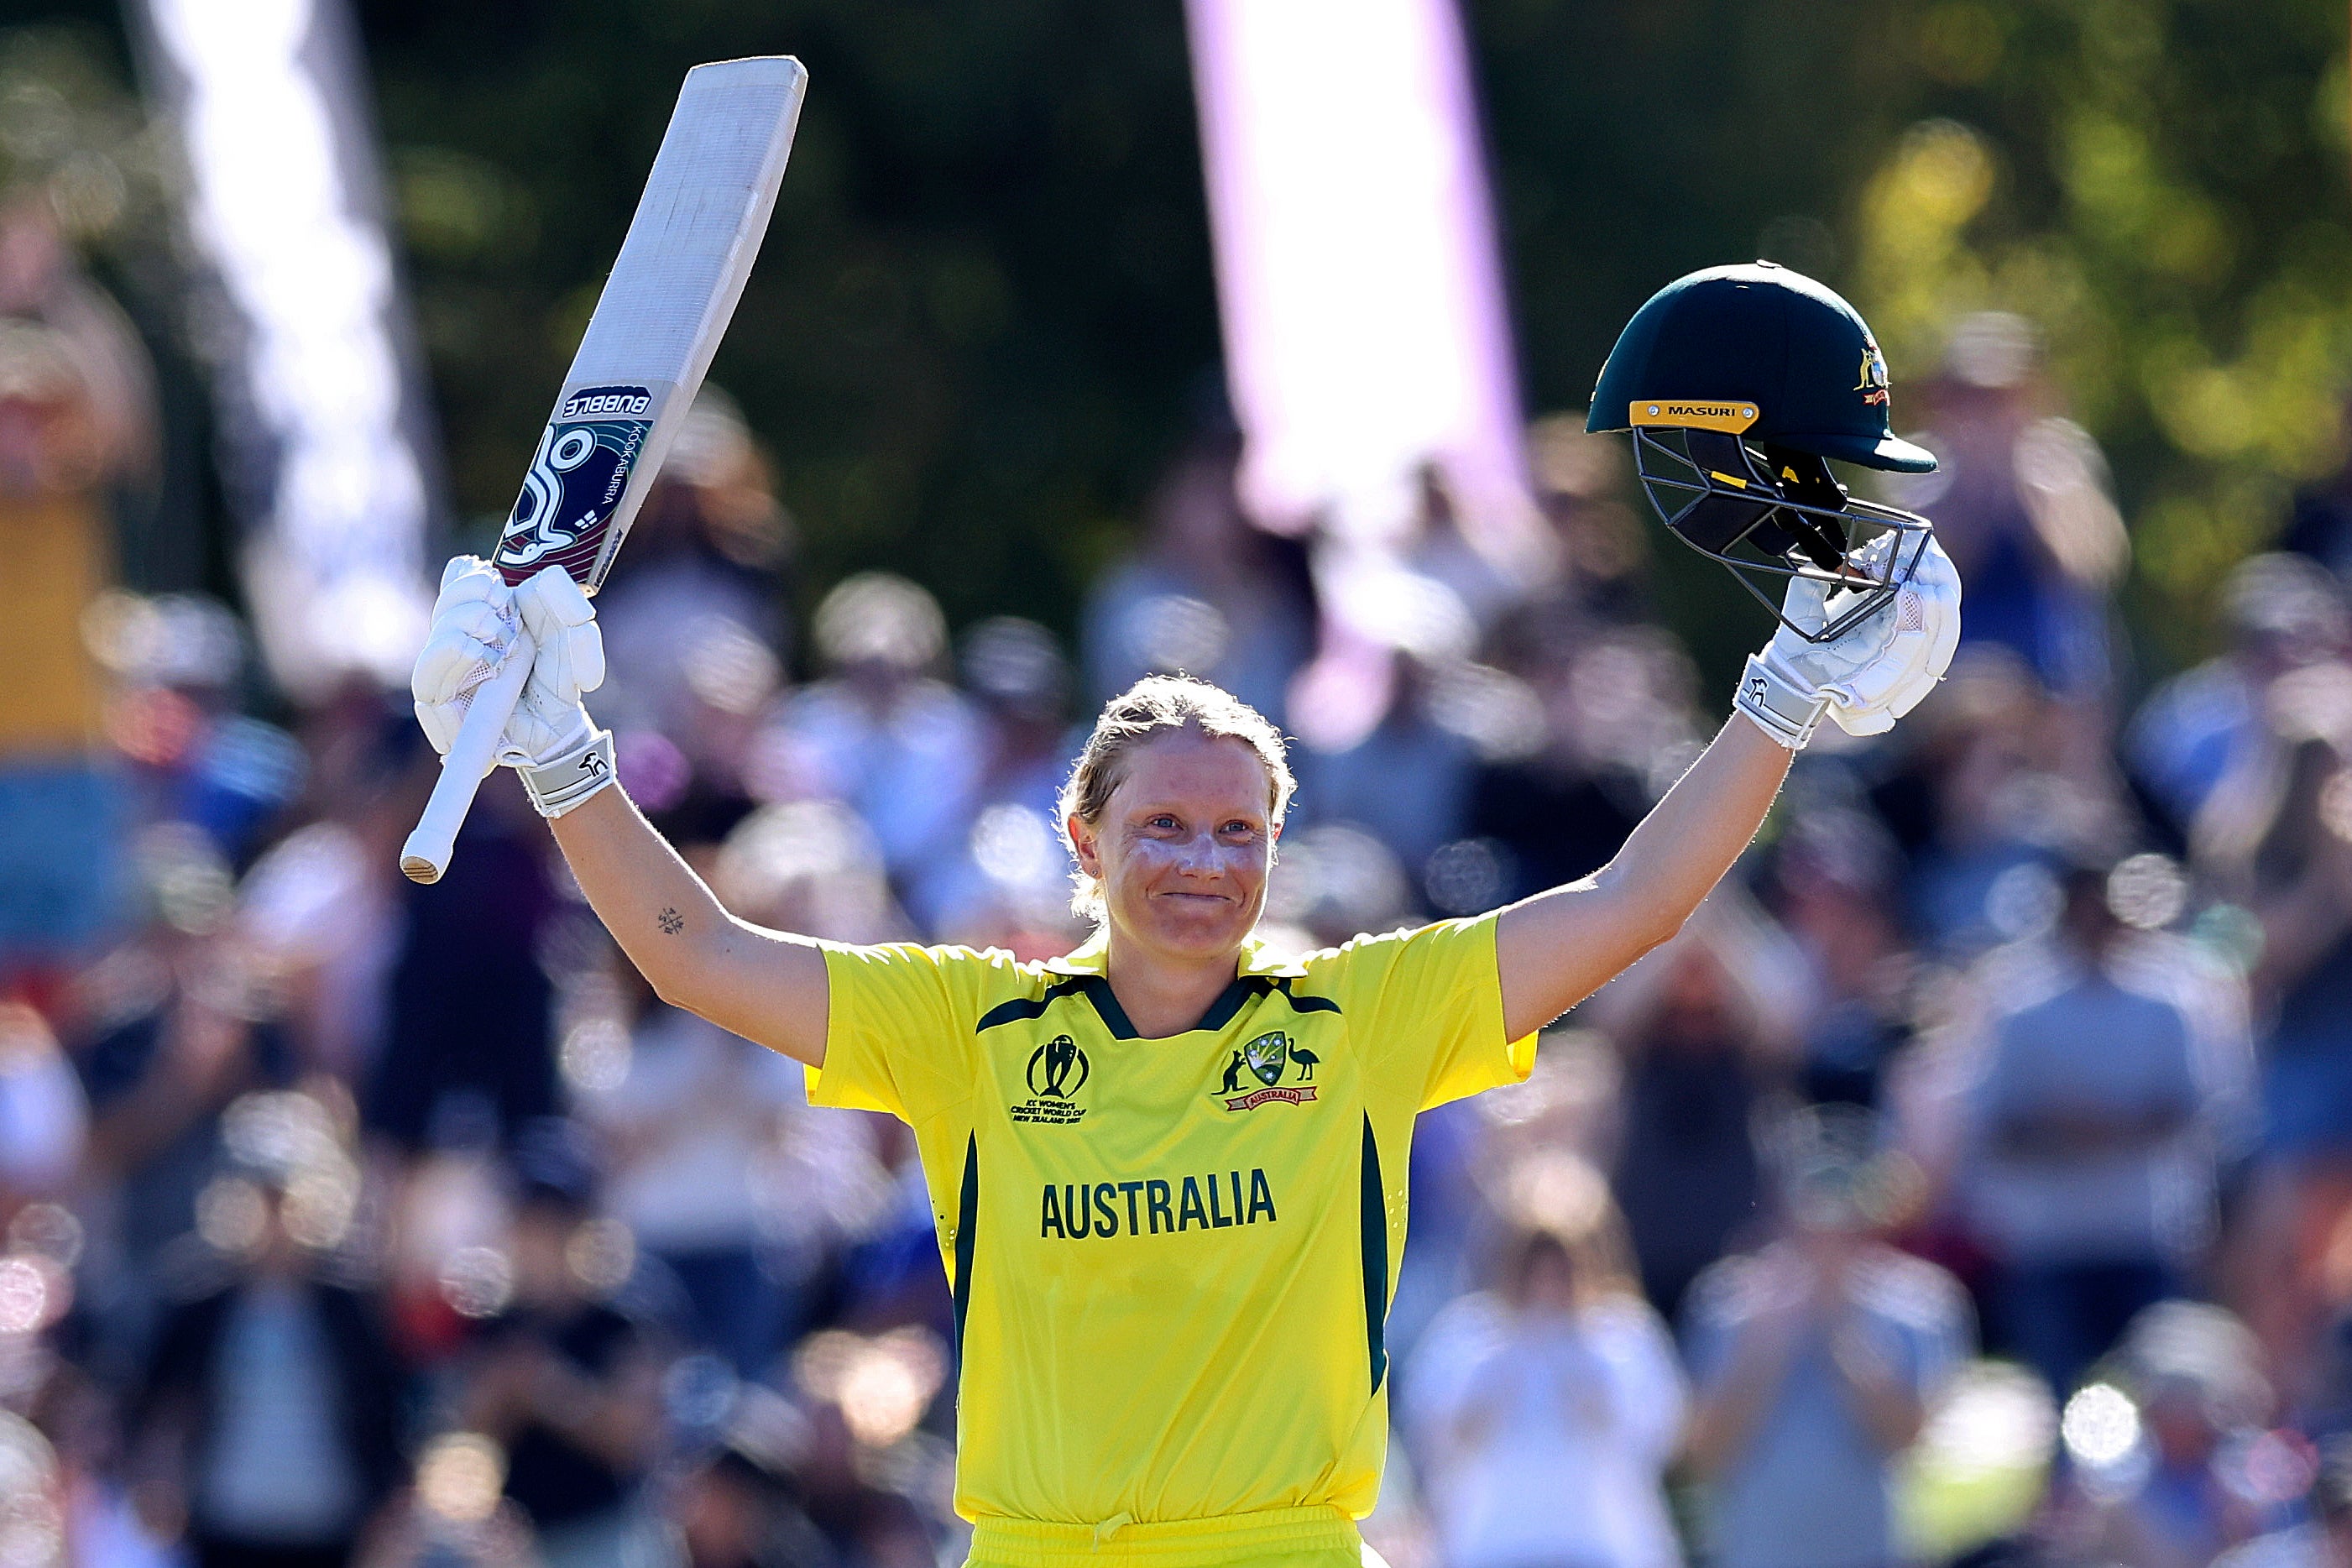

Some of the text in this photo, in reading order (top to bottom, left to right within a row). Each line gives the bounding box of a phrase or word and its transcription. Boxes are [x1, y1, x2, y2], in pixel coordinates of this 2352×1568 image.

[563, 394, 651, 417] BUBBLE
[1668, 406, 1735, 416] MASURI
[602, 426, 642, 504] KOOKABURRA
[1250, 1090, 1297, 1104] AUSTRALIA
[1011, 1105, 1087, 1116] CRICKET WORLD CUP
[1032, 1116, 1065, 1124] ZEALAND
[1041, 1168, 1277, 1240] AUSTRALIA
